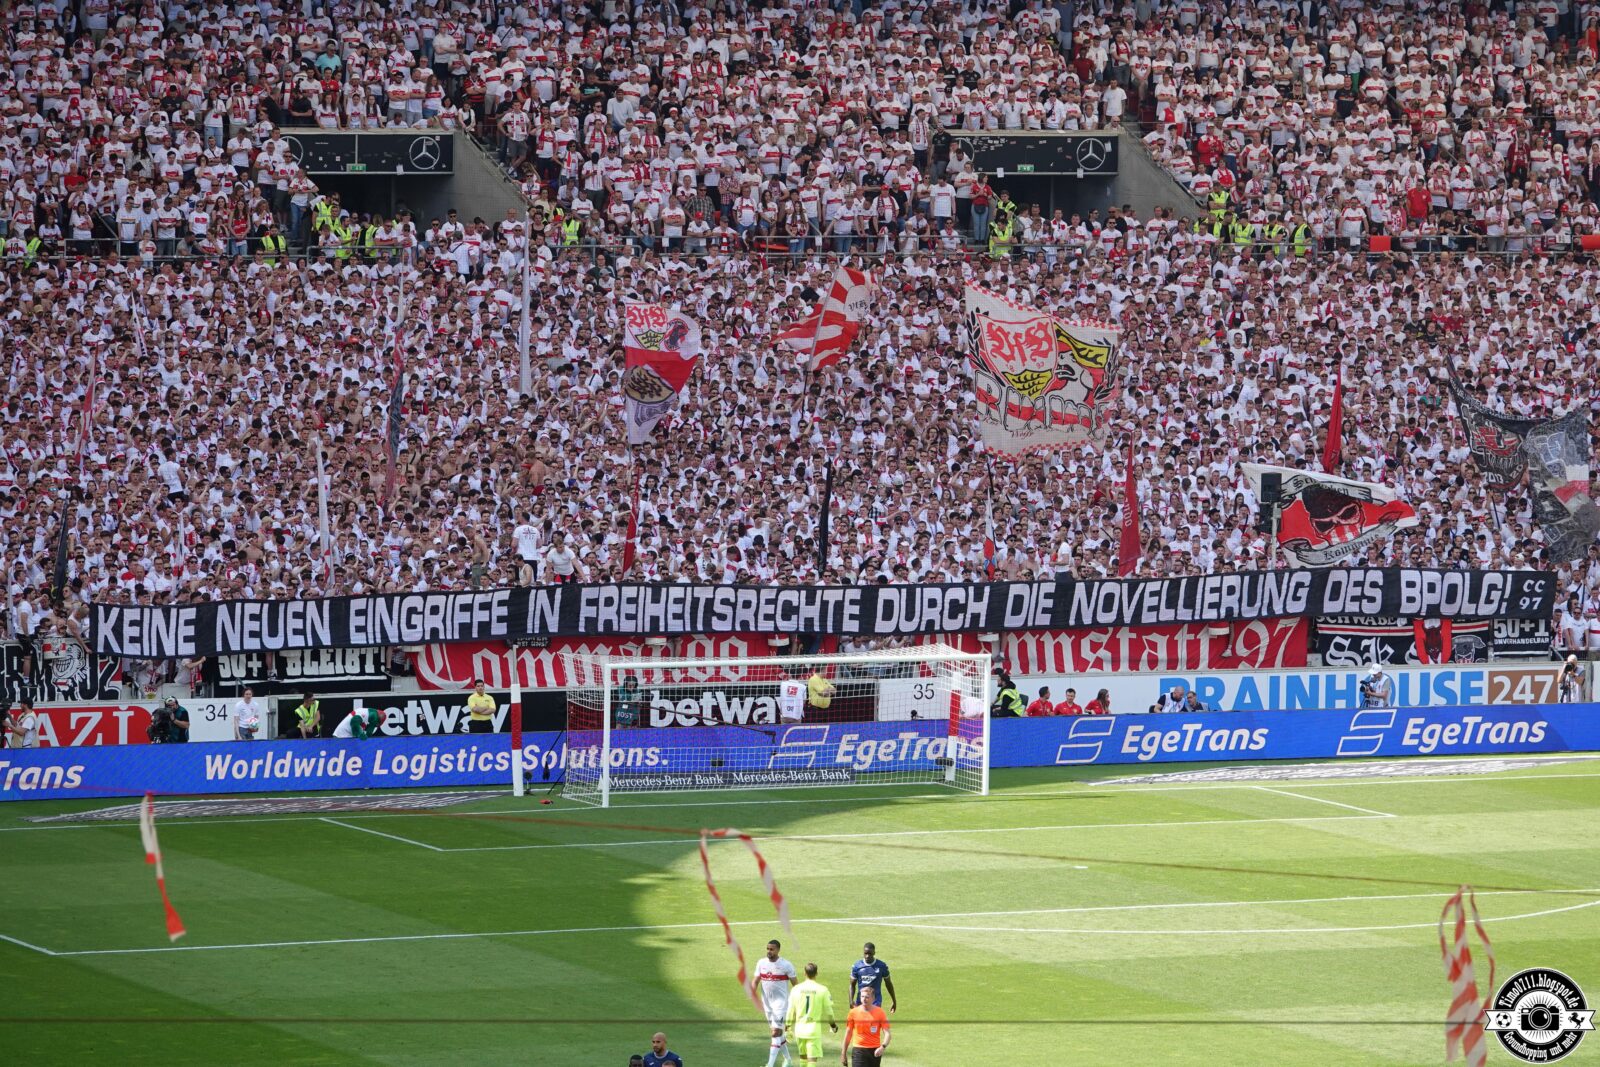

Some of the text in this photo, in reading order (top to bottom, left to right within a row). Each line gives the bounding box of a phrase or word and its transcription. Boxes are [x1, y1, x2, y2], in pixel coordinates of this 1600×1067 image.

[1523, 580, 1546, 592] CC
[97, 570, 1512, 656] KEINE NEUEN EINGRIFFE IN FREIHEITSRECHTE DURCH DIE NOVELLIERUNG DES BPOLG!
[1519, 597, 1543, 610] 97
[1493, 619, 1549, 638] 50+1
[1235, 617, 1300, 670] 97
[913, 683, 935, 700] 35
[1492, 674, 1554, 704] 247
[205, 704, 228, 721] 34
[649, 690, 782, 728] betwa
[1121, 723, 1269, 760] EgeTrans
[1402, 716, 1548, 753] EgeTrans
[205, 750, 363, 780] Worldwide
[372, 745, 510, 780] Logistics
[608, 774, 724, 788] Mercedes-Benz Bank
[732, 769, 850, 783] Mercedes-Benz Bank
